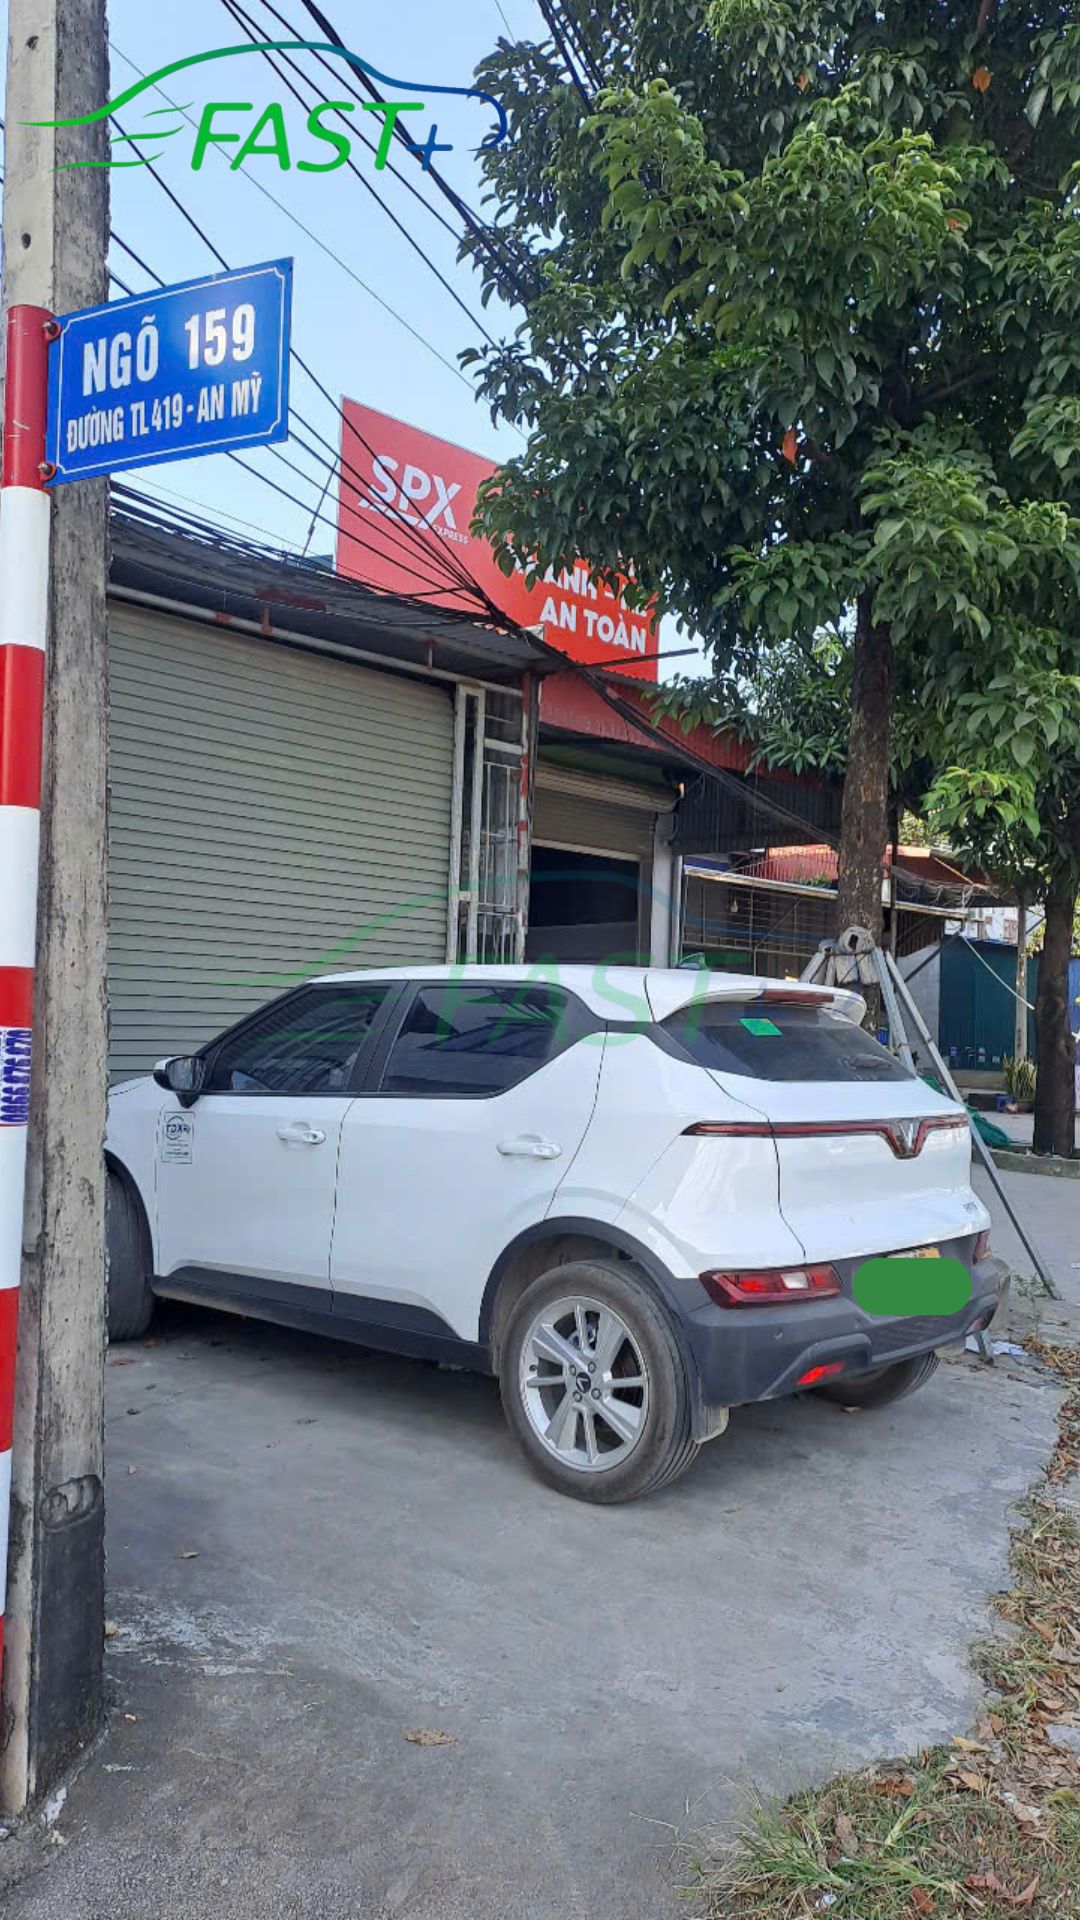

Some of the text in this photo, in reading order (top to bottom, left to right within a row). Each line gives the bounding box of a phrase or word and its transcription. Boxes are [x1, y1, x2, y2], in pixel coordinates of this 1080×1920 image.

[82, 303, 256, 397] NGÕ 159
[66, 405, 125, 453] ĐƯỜNG
[196, 383, 225, 424] AN
[230, 370, 262, 418] MỸ
[367, 455, 463, 530] SPX
[540, 596, 577, 632] AN
[583, 608, 646, 654] TOÀN
